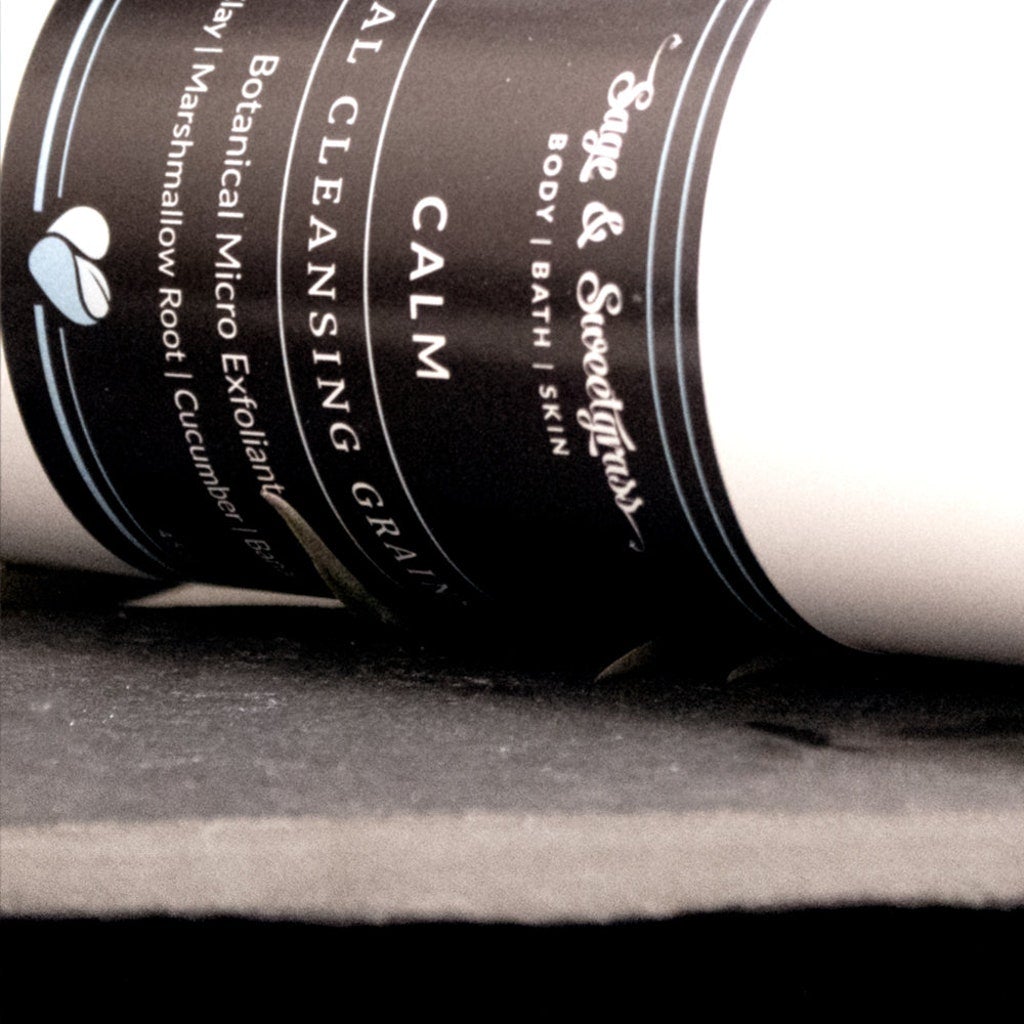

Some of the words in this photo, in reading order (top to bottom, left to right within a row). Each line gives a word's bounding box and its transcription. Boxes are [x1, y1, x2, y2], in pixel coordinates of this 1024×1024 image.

[158, 63, 215, 277] Marshmallow
[218, 54, 280, 218] Botanical
[579, 33, 682, 182] Sage
[536, 133, 568, 222] BODY
[577, 201, 624, 249] &
[158, 287, 186, 362] Root
[214, 233, 243, 339] Micro
[308, 95, 360, 453] CLEANSING
[409, 196, 451, 380] CALM
[531, 261, 551, 347] BATH
[174, 388, 243, 523] Cucumber
[221, 352, 285, 495] Exfoliant
[538, 384, 570, 456] SKIN
[576, 271, 644, 552] Sweetgrass
